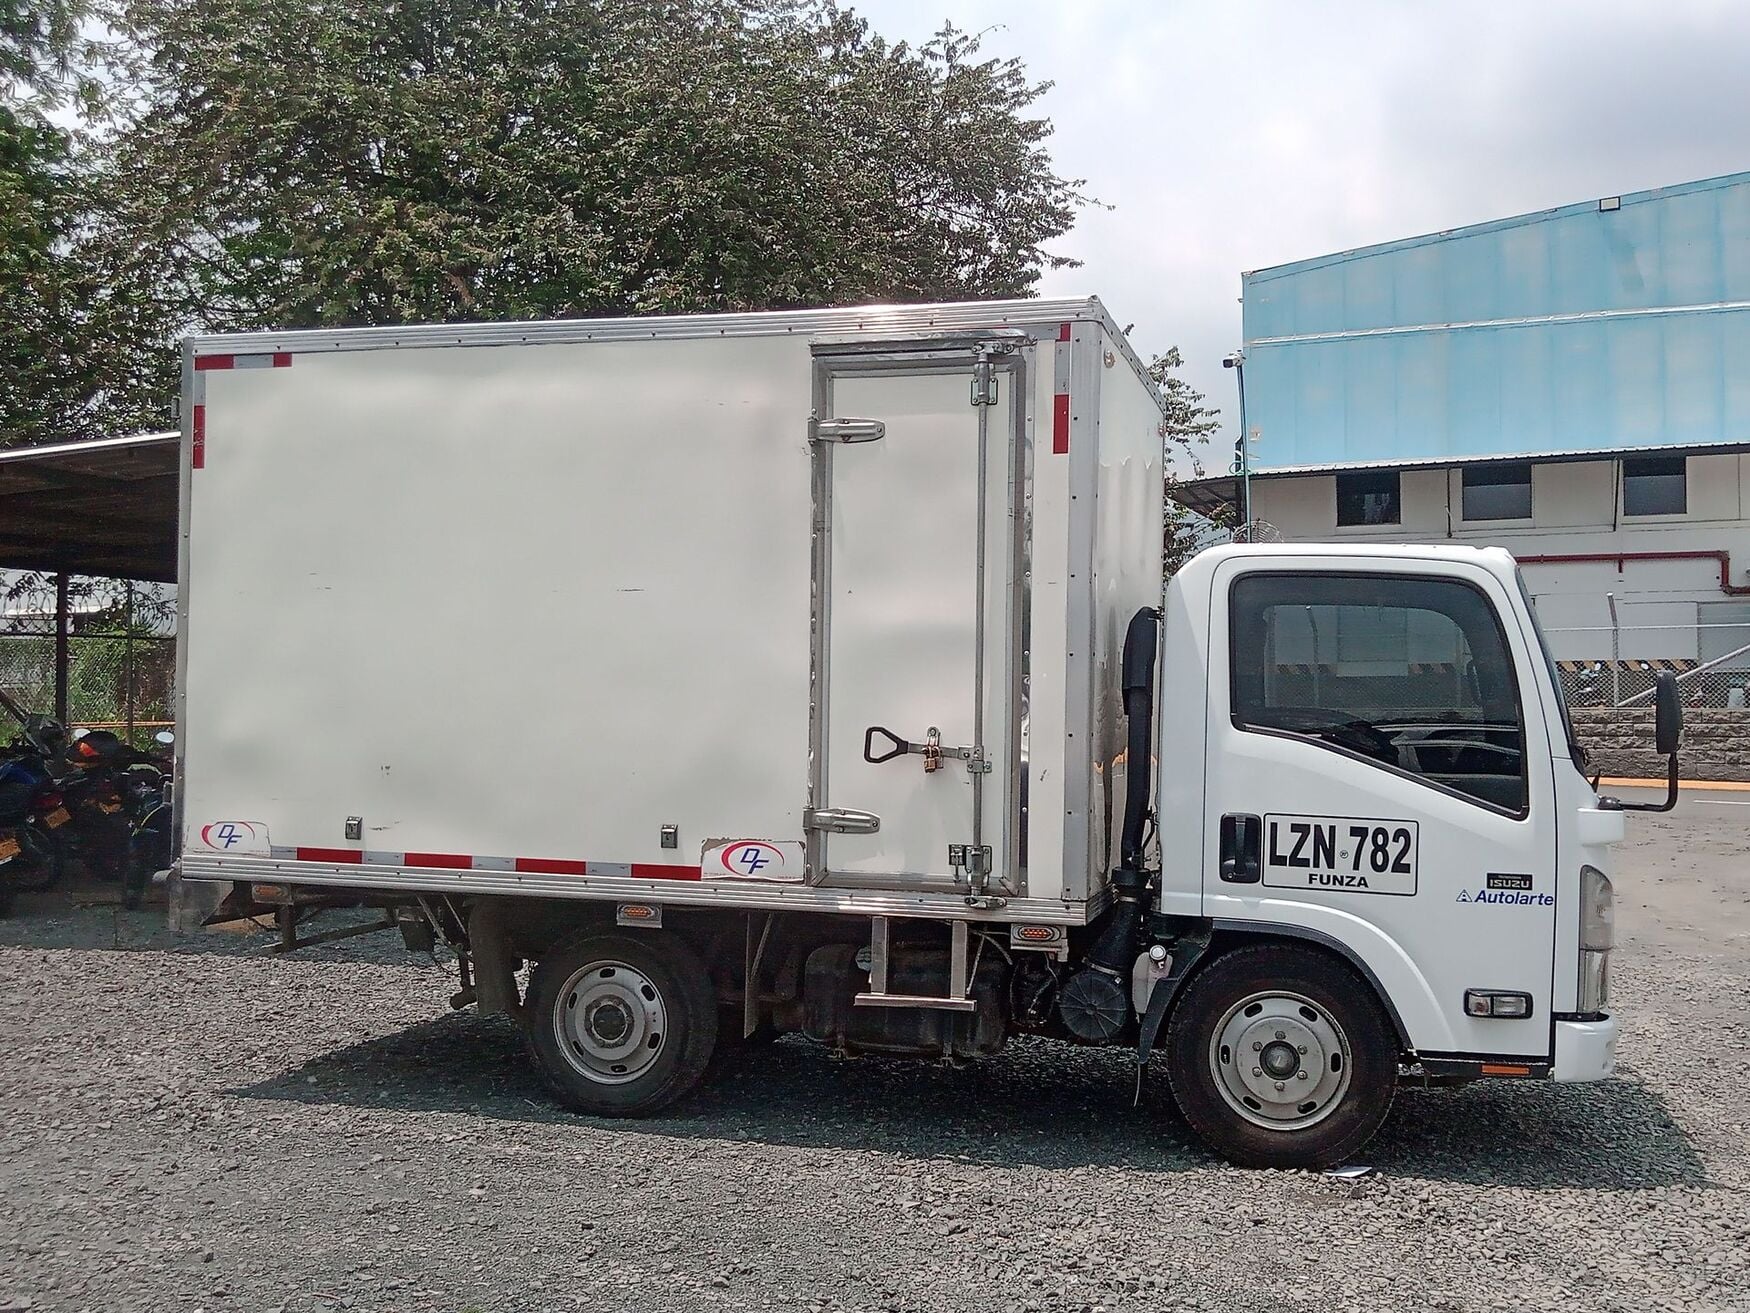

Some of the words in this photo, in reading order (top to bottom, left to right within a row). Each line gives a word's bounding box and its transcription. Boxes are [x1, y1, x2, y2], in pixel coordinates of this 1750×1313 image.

[1269, 821, 1336, 869] LZN
[1349, 826, 1412, 874] 782
[1308, 873, 1370, 889] FUNZA
[1489, 879, 1530, 888] ISUZU
[1474, 889, 1554, 906] Autolarte
